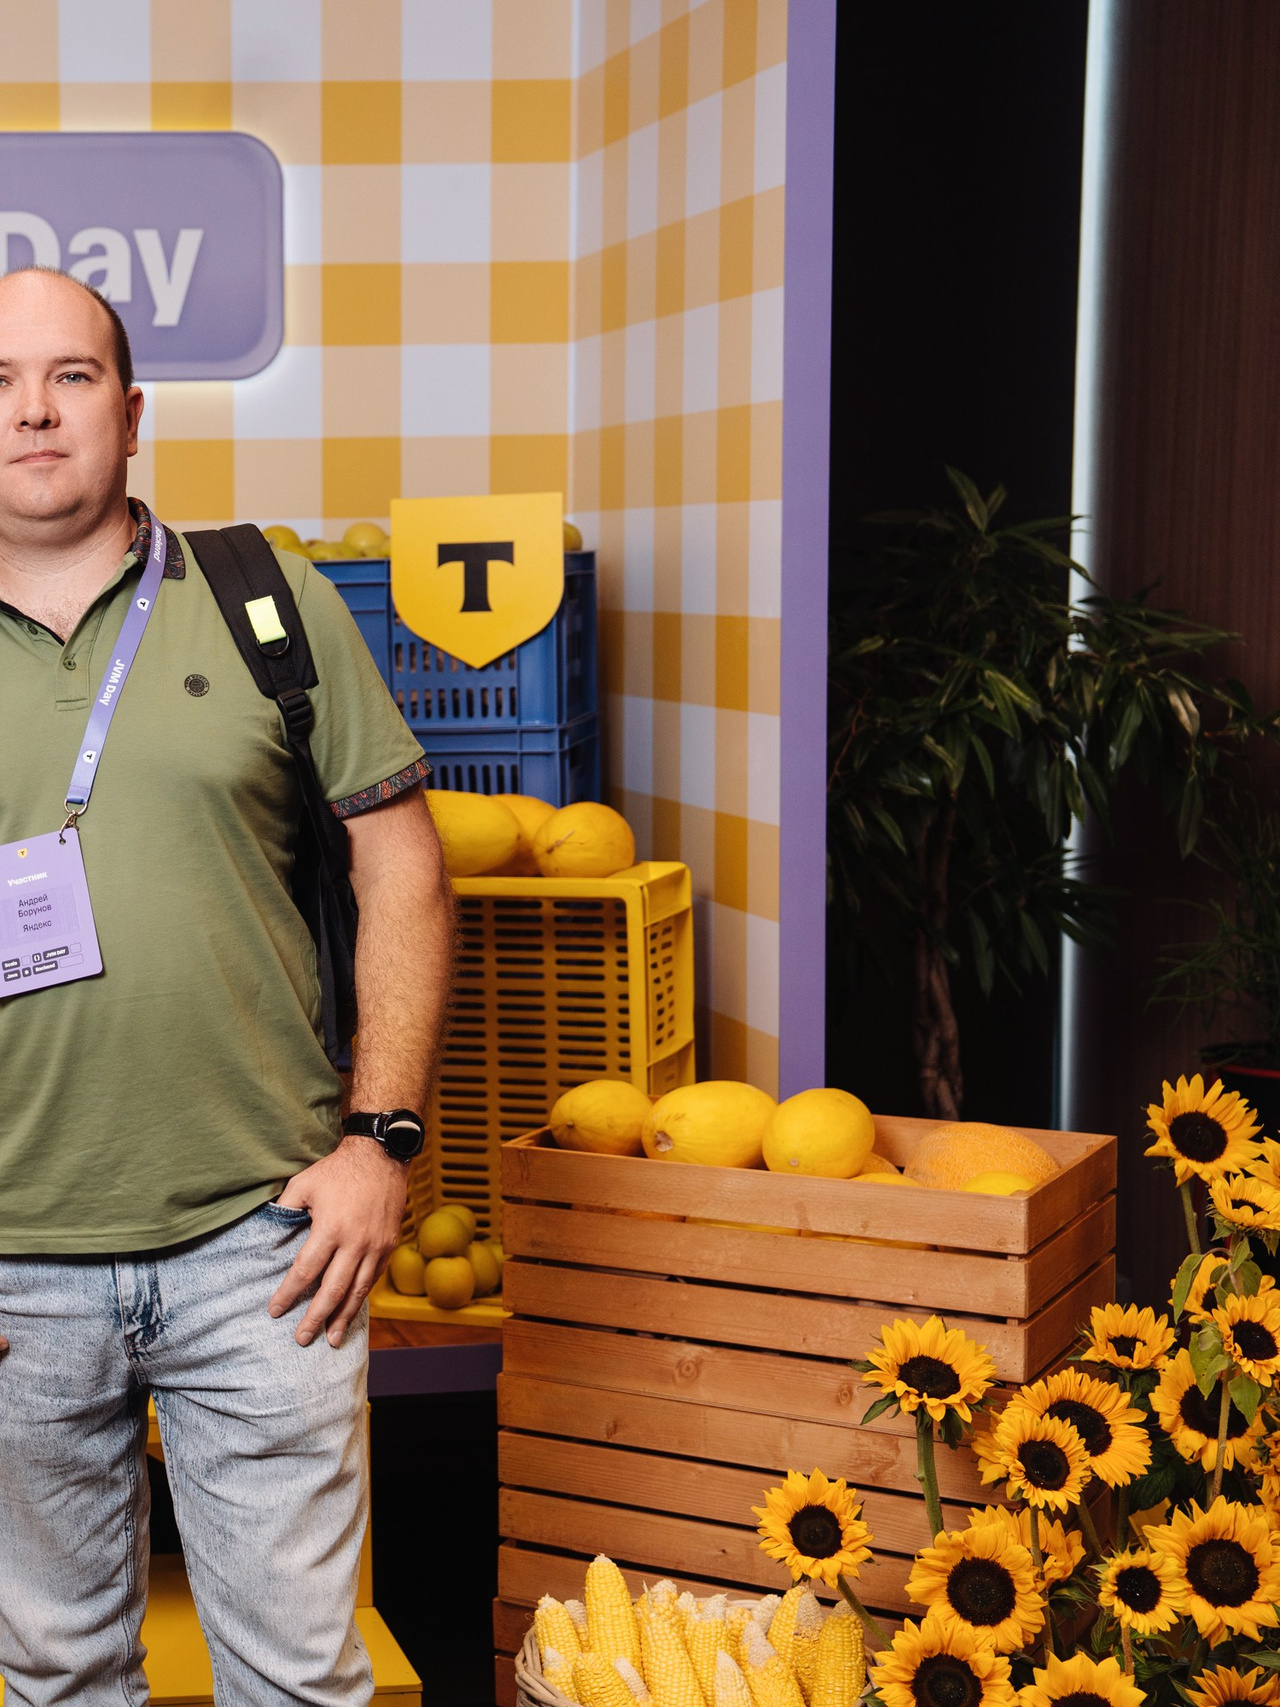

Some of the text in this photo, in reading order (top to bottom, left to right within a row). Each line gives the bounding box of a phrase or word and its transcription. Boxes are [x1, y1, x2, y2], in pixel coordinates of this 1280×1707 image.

[437, 541, 514, 612] T
[99, 659, 125, 706] JVM Day
[7, 871, 48, 887] Участник
[18, 893, 48, 908] Андрей
[18, 904, 52, 918] Борунов
[23, 920, 52, 933] Яндекс
